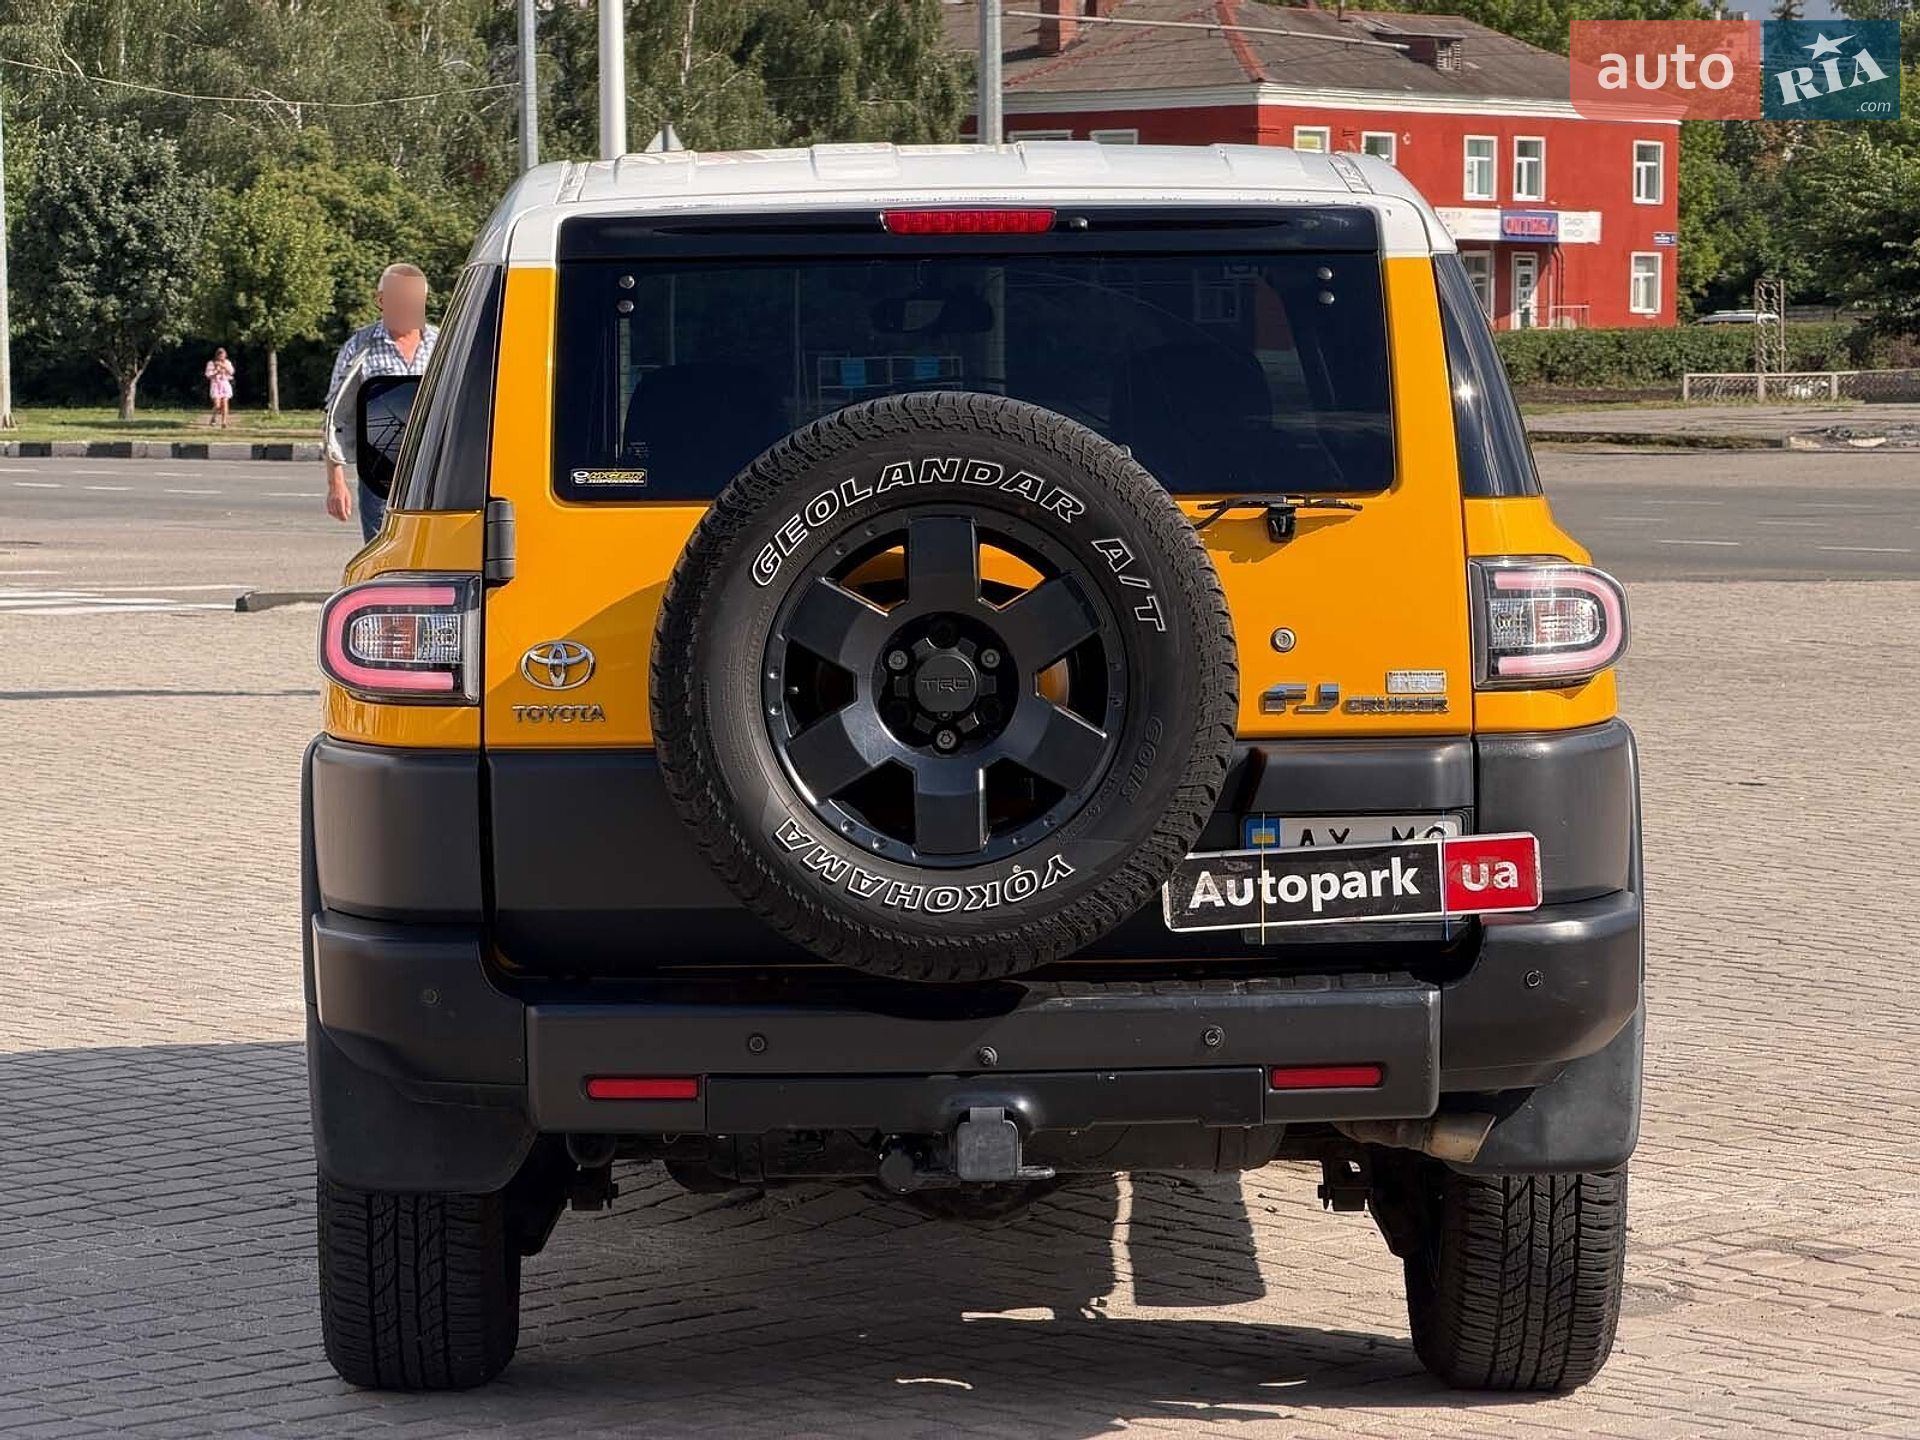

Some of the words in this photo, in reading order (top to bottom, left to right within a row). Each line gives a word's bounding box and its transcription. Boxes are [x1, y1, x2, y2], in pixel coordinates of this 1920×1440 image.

[752, 458, 1084, 587] GEOLANDAR
[1093, 537, 1167, 634] A/T
[512, 704, 606, 722] TOYOTA
[776, 817, 1076, 913] YOKOHAMA
[1188, 857, 1421, 912] Autopark
[1461, 859, 1520, 893] ua
